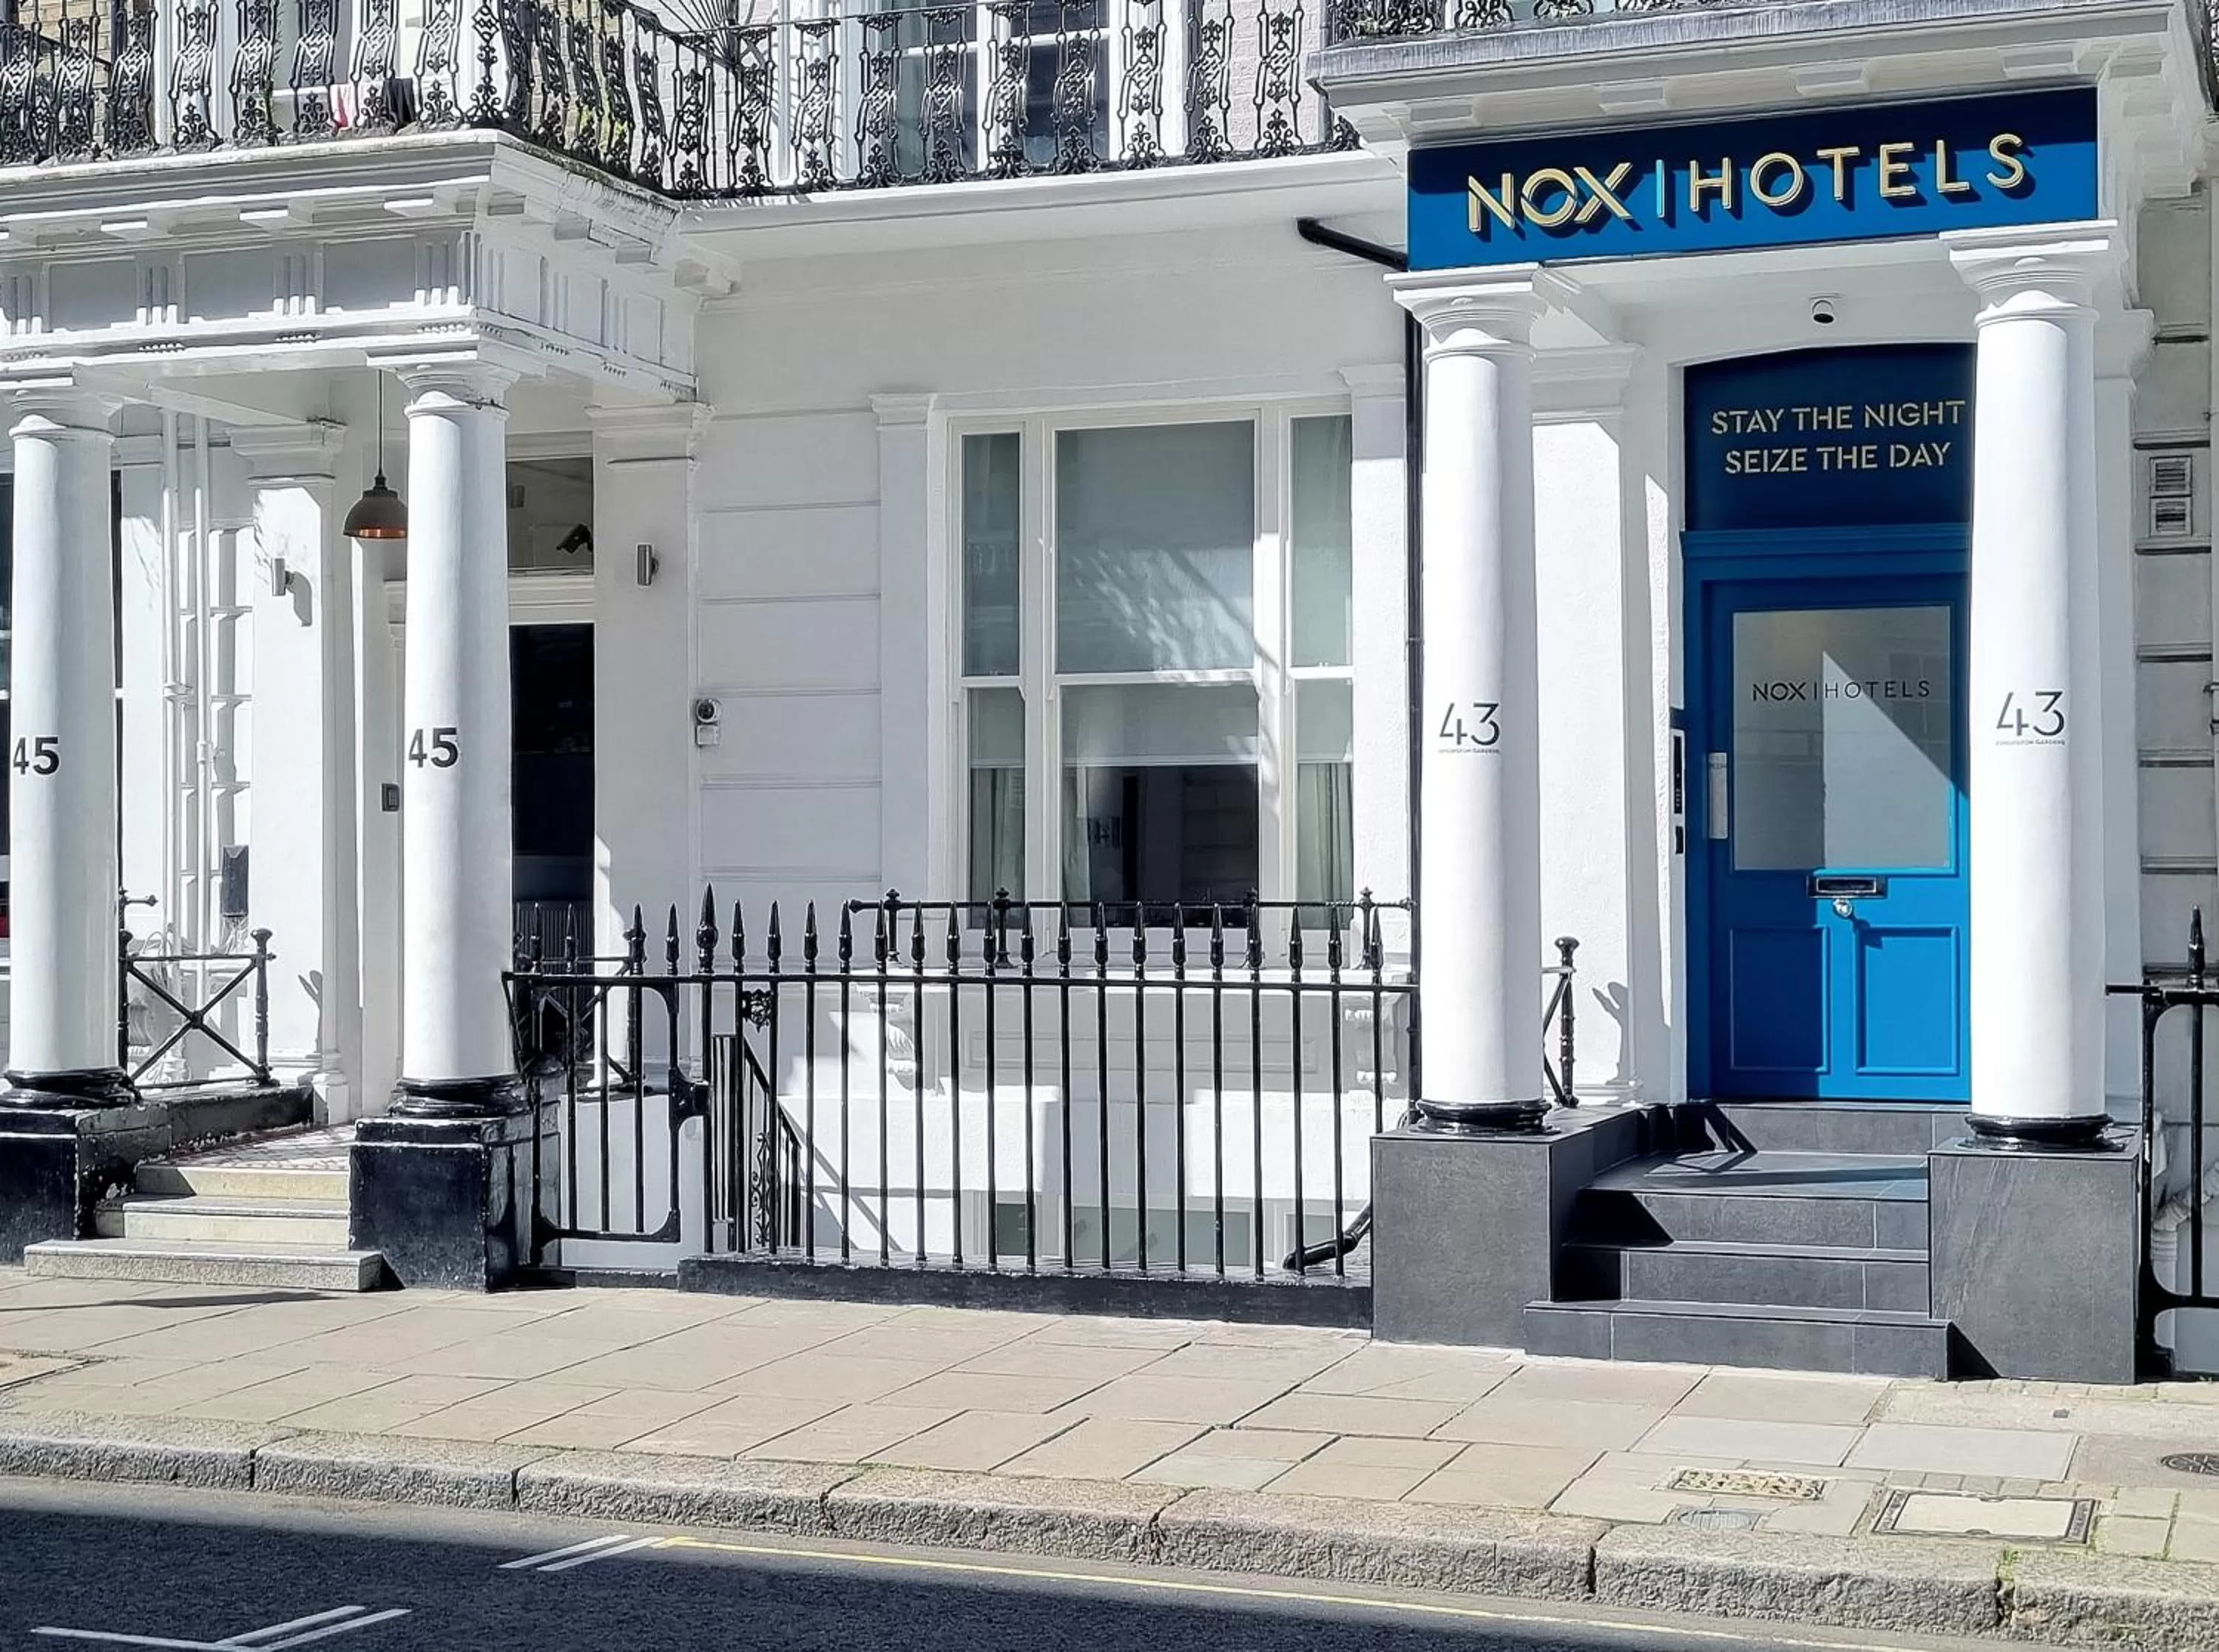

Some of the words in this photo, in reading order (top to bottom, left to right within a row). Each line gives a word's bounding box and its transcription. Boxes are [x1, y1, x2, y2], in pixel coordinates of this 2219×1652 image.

[1468, 162, 1632, 232] NOX
[1689, 133, 2024, 212] HOTELS
[1712, 409, 1784, 434] STAY
[1791, 406, 1853, 430] THE
[1864, 400, 1965, 428] NIGHT
[1725, 447, 1807, 474] SEIZE
[1816, 445, 1877, 470] THE
[1889, 442, 1951, 467] DAY
[1752, 682, 1806, 701] NOX
[1824, 680, 1930, 699] HOTELS
[1439, 702, 1500, 745] 43
[1996, 691, 2064, 737] 43
[12, 736, 61, 776] 45
[409, 727, 459, 768] 45
